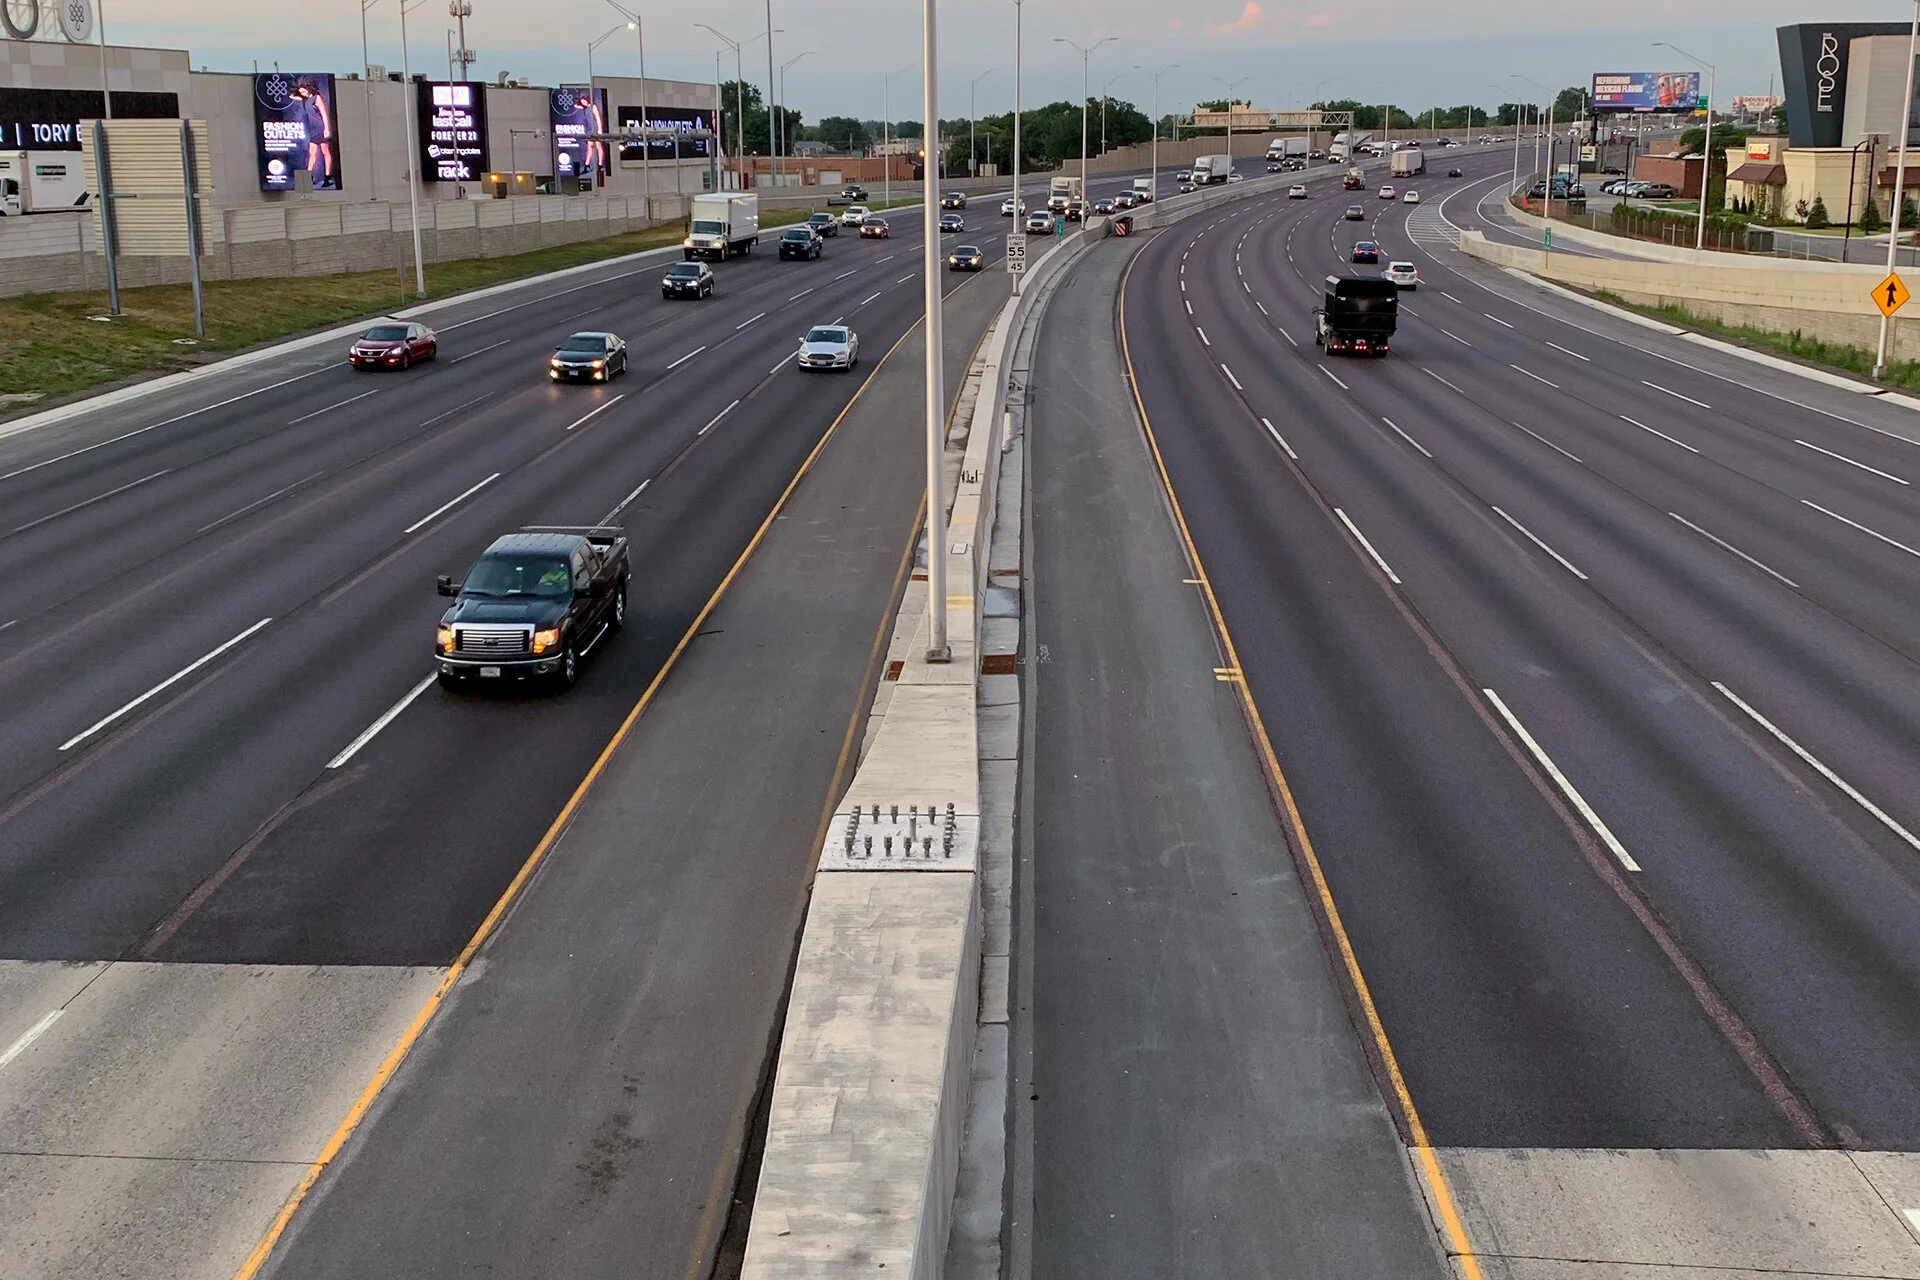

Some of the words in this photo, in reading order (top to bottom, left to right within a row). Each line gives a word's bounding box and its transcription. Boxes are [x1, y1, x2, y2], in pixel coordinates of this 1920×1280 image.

[1817, 36, 1839, 107] ROSE
[1595, 85, 1621, 94] MEXICAN
[1622, 85, 1644, 93] FLAVOR
[263, 121, 304, 131] FASHION
[32, 123, 71, 142] TORY
[264, 130, 306, 139] OUTLETS
[1008, 247, 1024, 257] 55
[1010, 262, 1022, 270] 45
